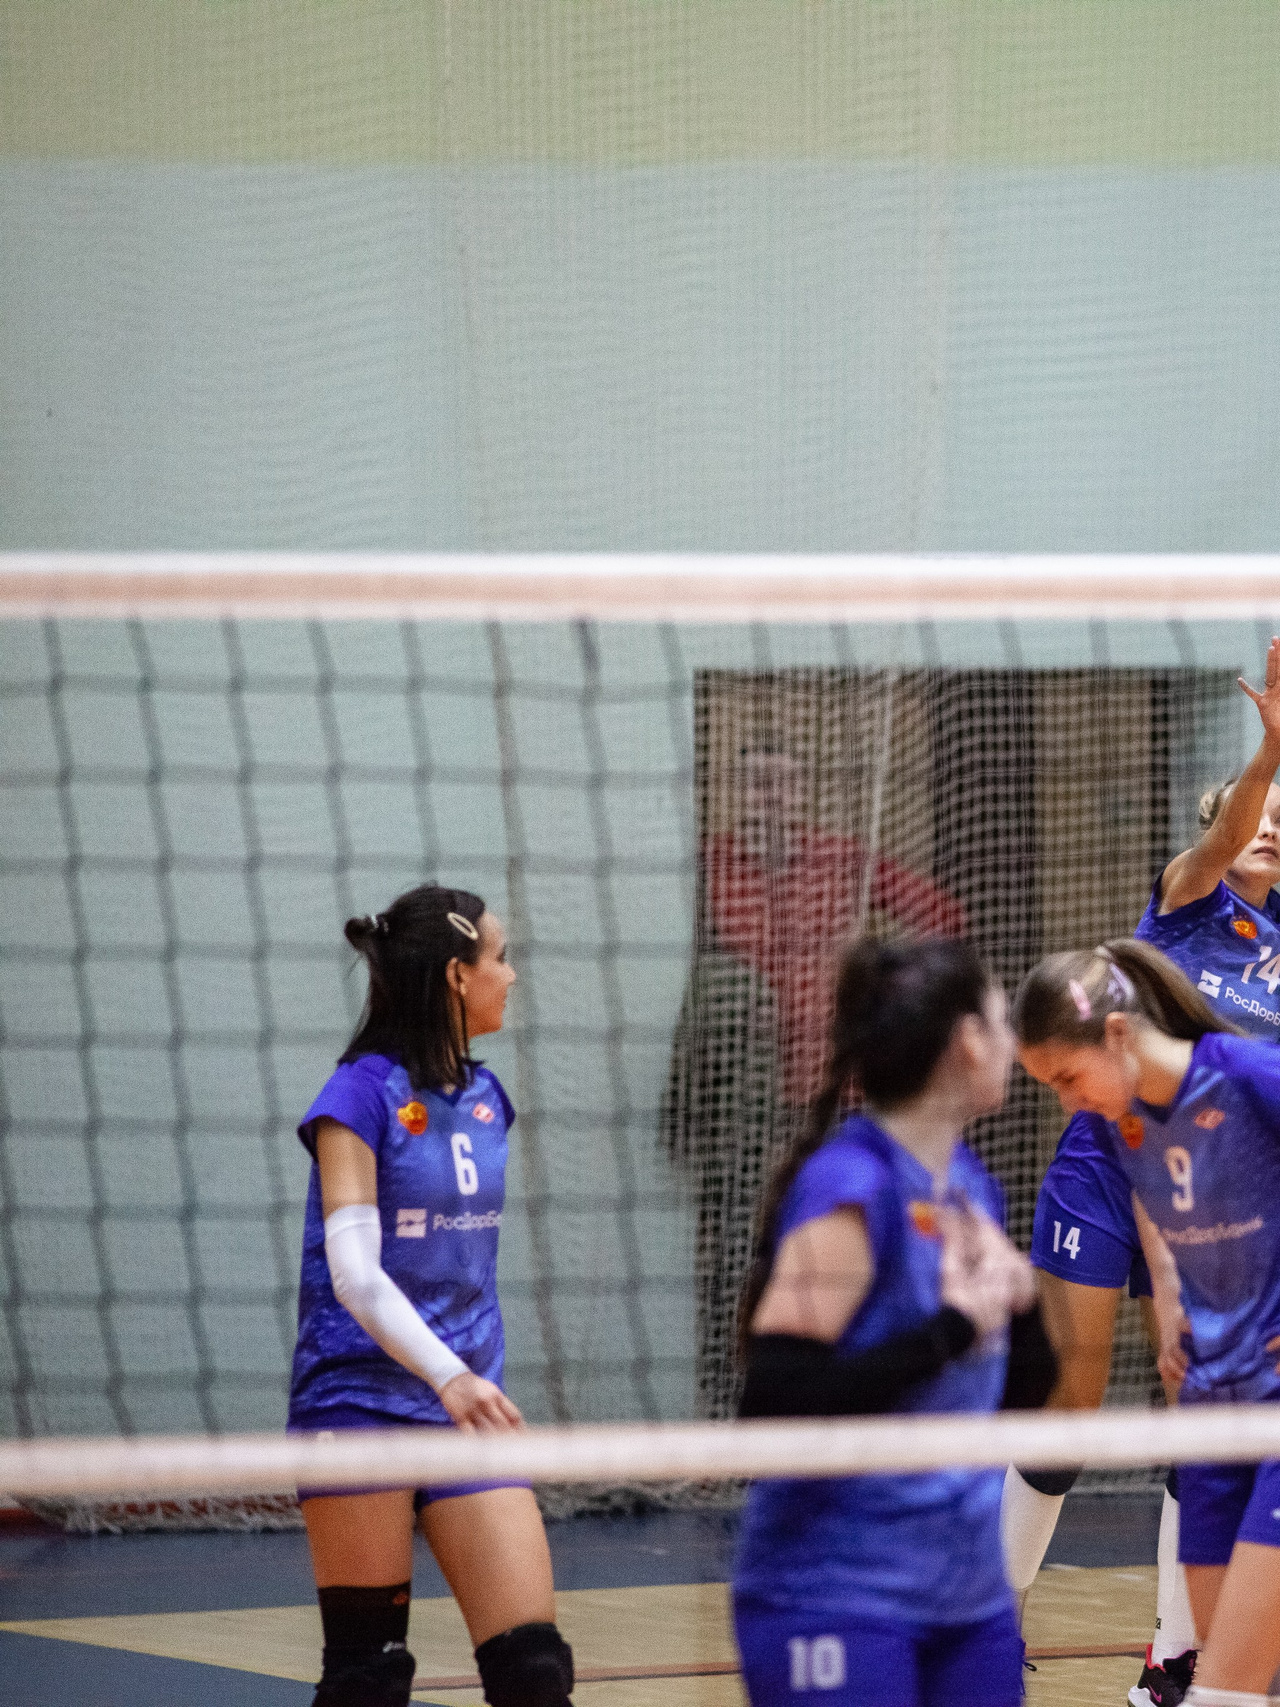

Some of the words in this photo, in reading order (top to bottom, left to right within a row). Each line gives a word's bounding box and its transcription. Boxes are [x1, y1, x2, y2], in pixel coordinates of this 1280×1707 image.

[450, 1132, 479, 1196] 6
[1164, 1146, 1194, 1212] 9
[1053, 1220, 1081, 1260] 14
[787, 1635, 847, 1691] 10
